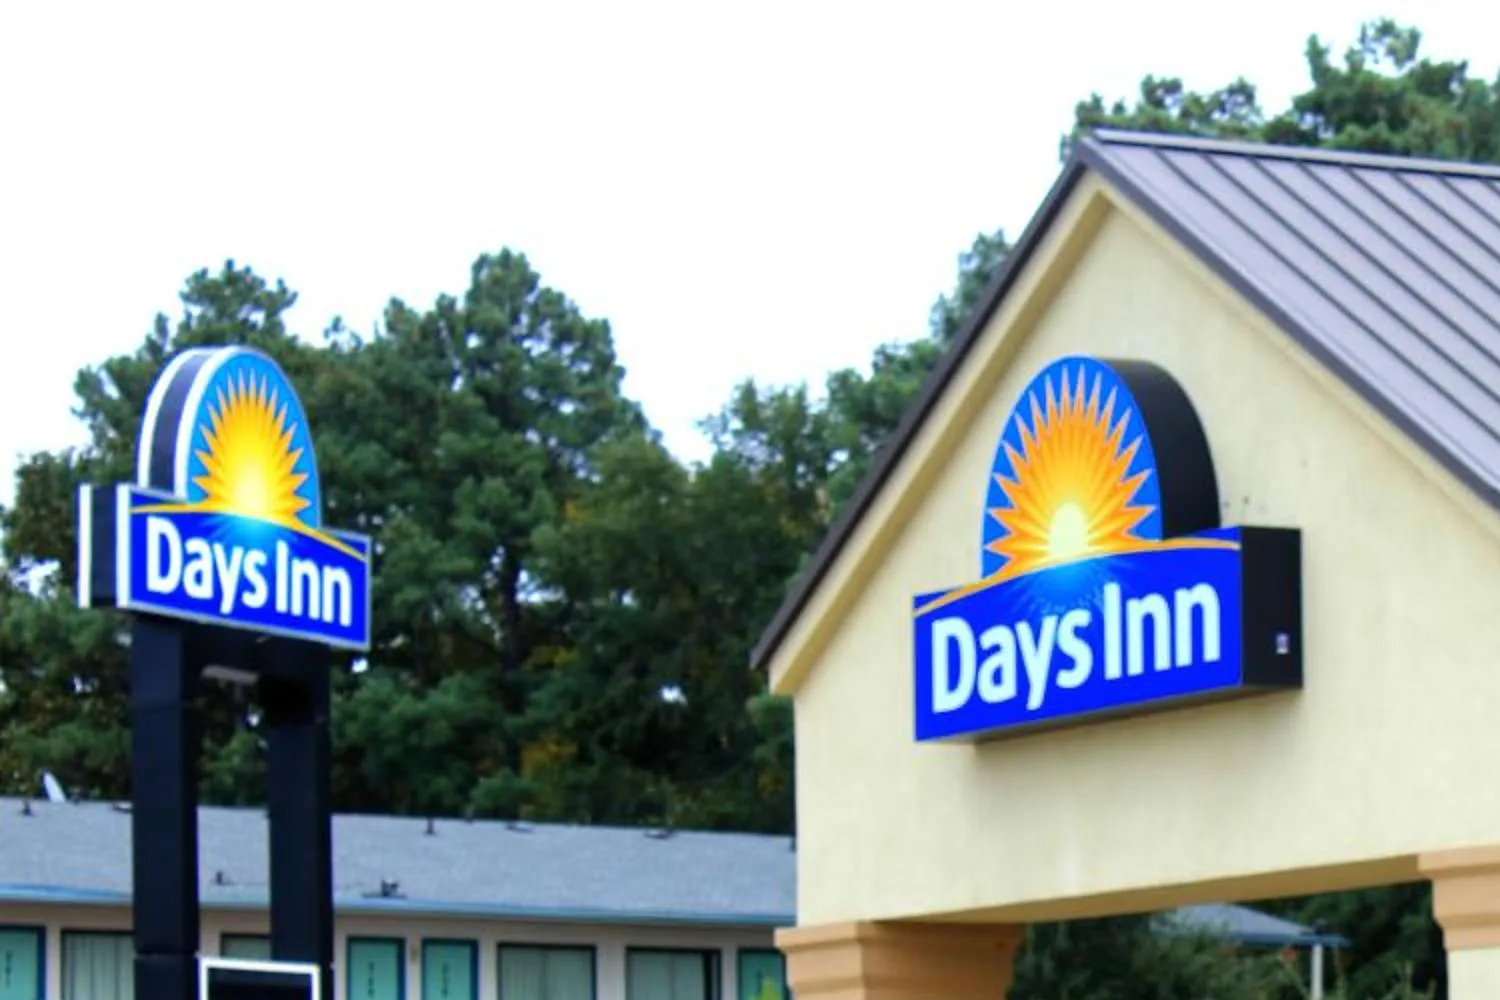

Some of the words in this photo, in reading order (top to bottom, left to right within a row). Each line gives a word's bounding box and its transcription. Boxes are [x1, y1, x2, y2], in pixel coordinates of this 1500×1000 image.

[146, 515, 268, 615] Days
[275, 539, 351, 627] Inn
[931, 608, 1093, 713] Days
[1103, 581, 1221, 681] Inn
